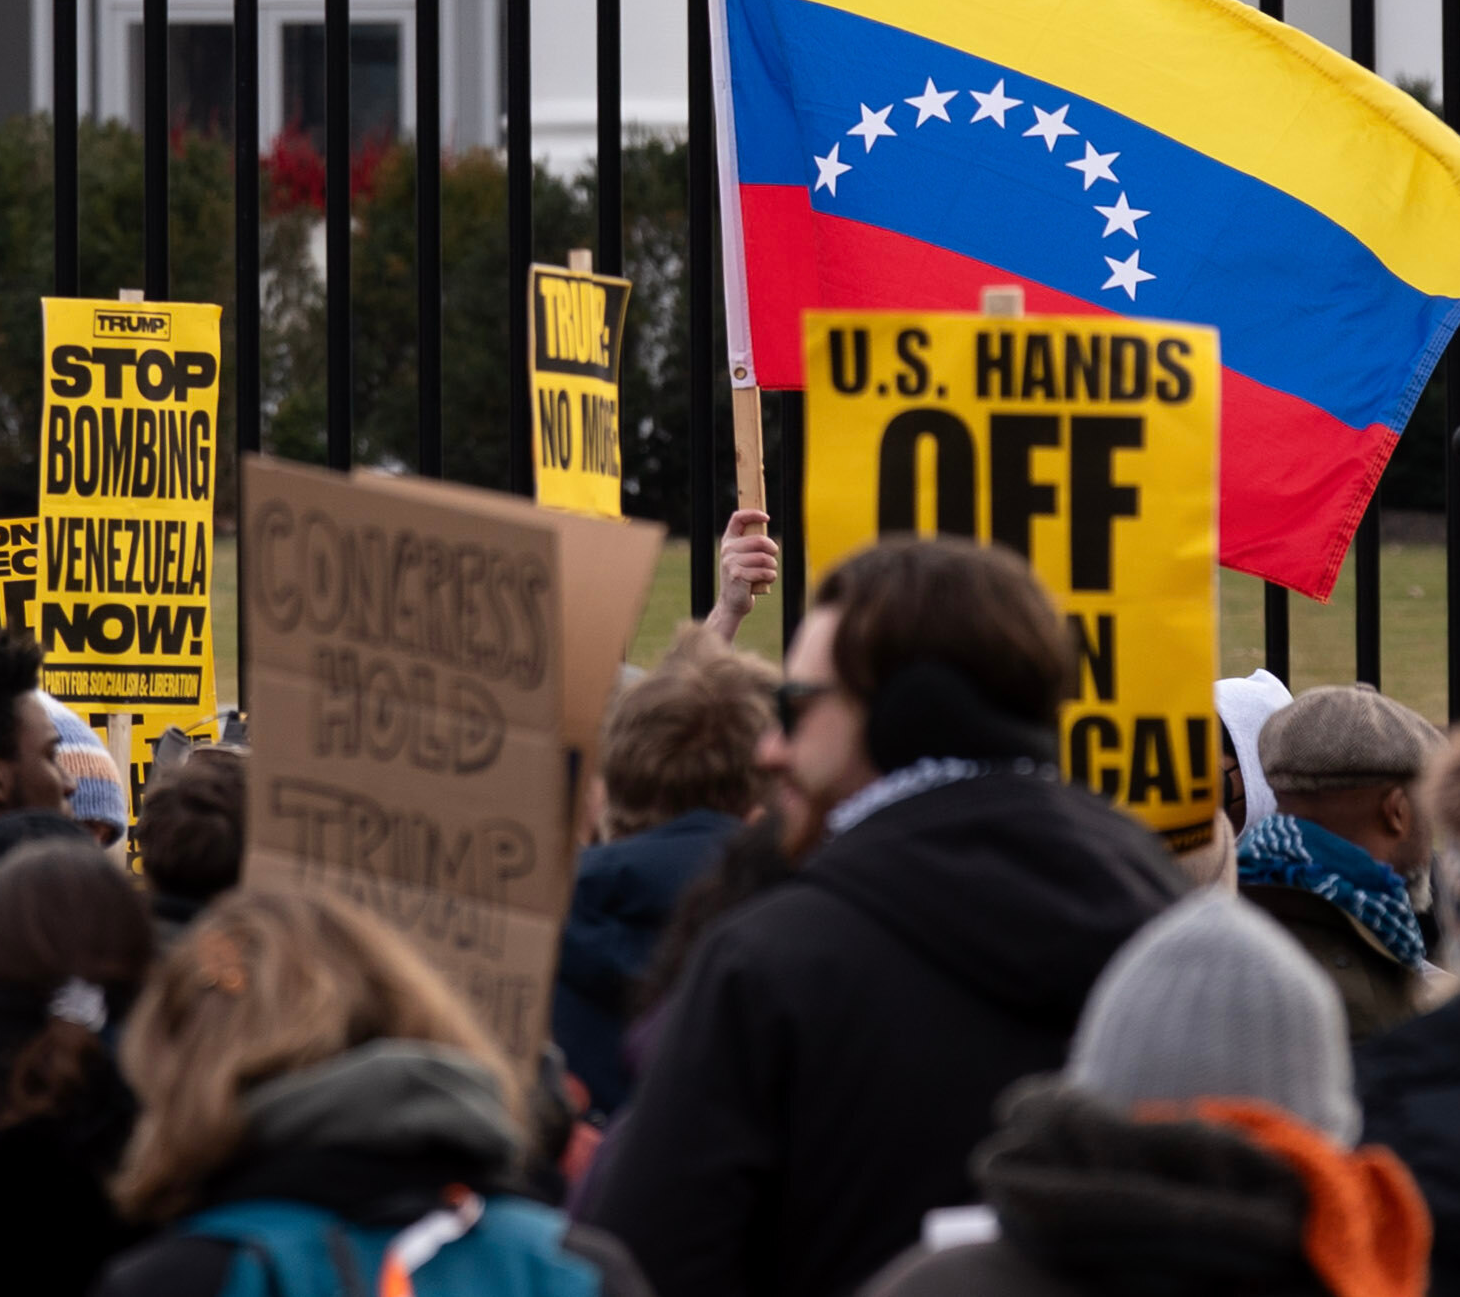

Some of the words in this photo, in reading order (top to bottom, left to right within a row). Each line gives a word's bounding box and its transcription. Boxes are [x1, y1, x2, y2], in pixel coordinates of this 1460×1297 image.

[97, 314, 166, 334] TRUMP
[50, 344, 217, 403] STOP
[828, 328, 948, 399] U.S.
[975, 330, 1195, 406] HANDS
[45, 404, 211, 502] BOMBING
[538, 388, 573, 472] NO
[877, 407, 1146, 595] OFF
[44, 516, 207, 596] VENEZUELA
[252, 497, 552, 693] CONGRESS
[41, 601, 207, 656] NOW!
[45, 670, 71, 695] PARTY
[72, 670, 89, 695] FOR
[90, 671, 139, 697] SOCIALISM
[139, 673, 149, 697] &
[150, 672, 200, 698] LIBERATION
[313, 642, 508, 775] HOLD
[269, 774, 538, 956] TRUMP
